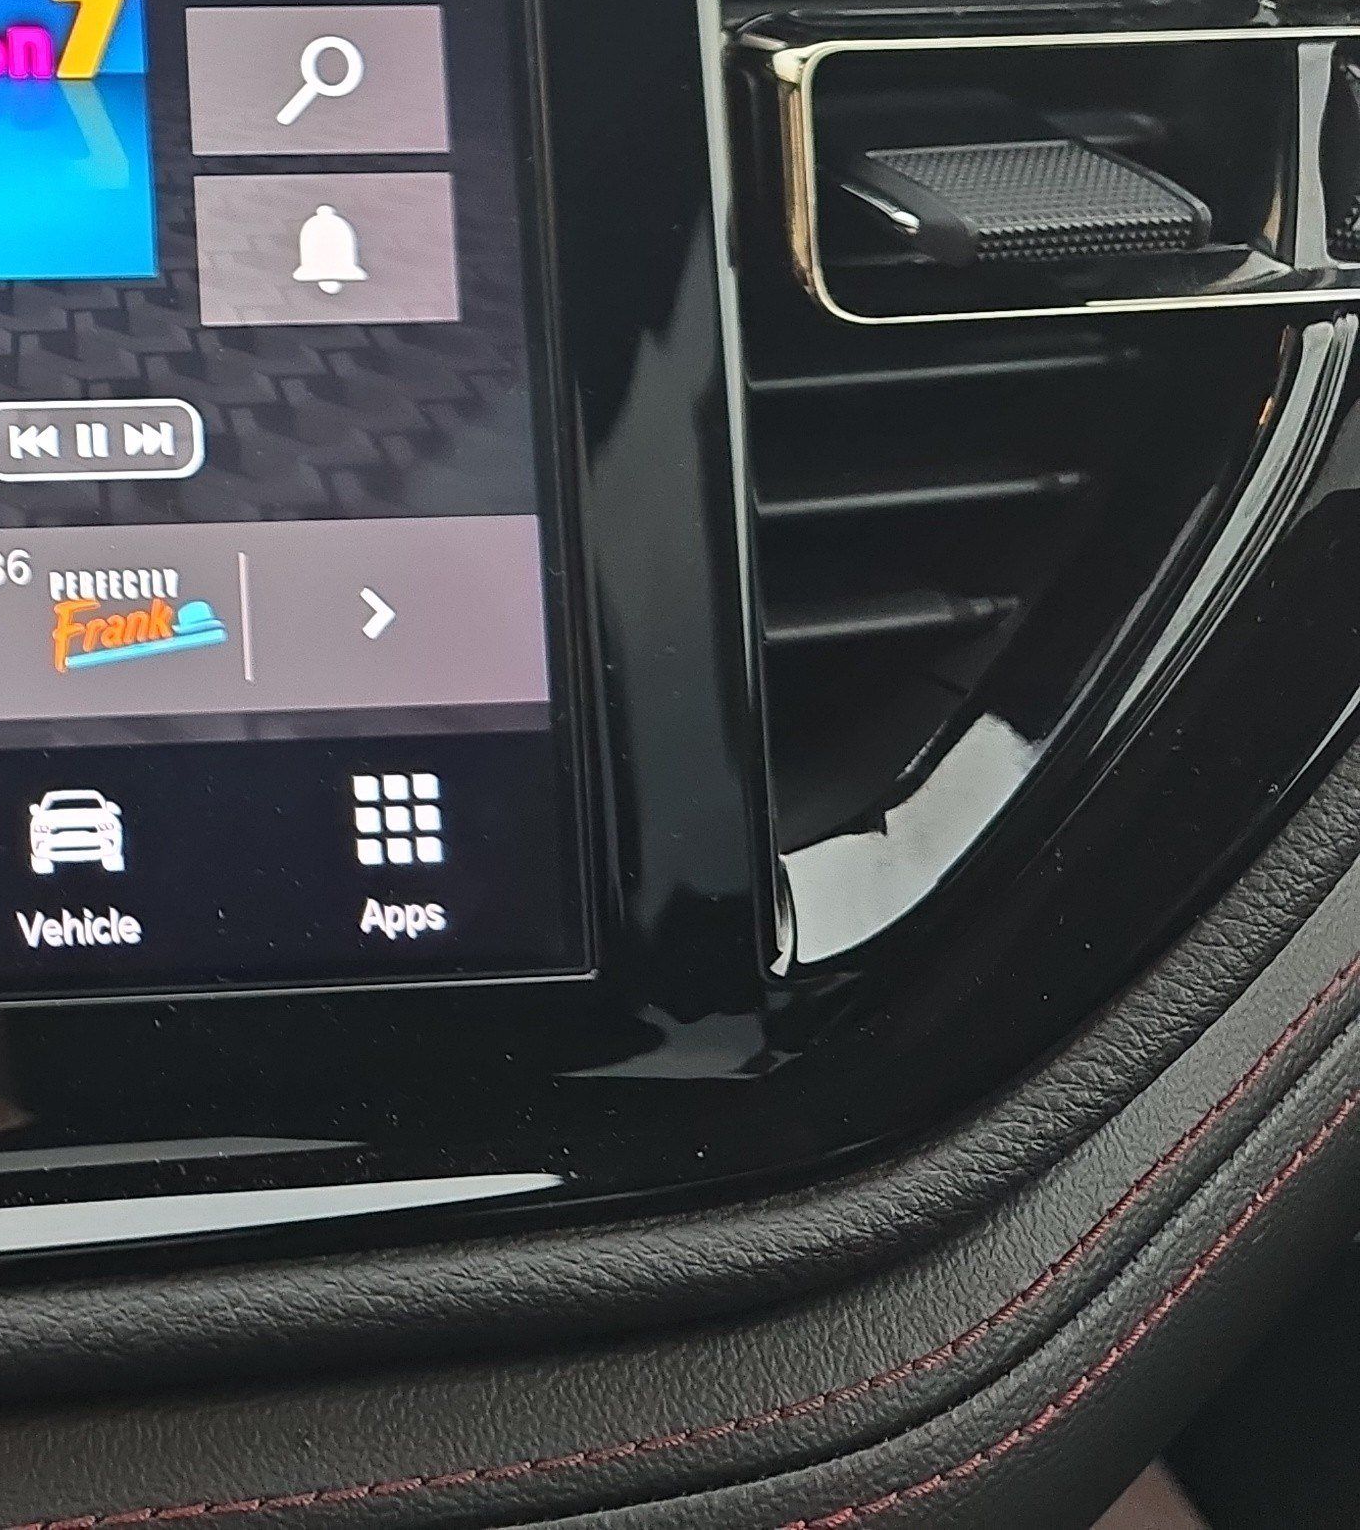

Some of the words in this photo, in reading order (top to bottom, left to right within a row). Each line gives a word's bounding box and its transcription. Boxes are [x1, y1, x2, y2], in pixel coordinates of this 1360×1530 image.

[52, 598, 173, 672] Frank
[17, 909, 142, 947] Vehicle
[361, 900, 447, 937] Apps
